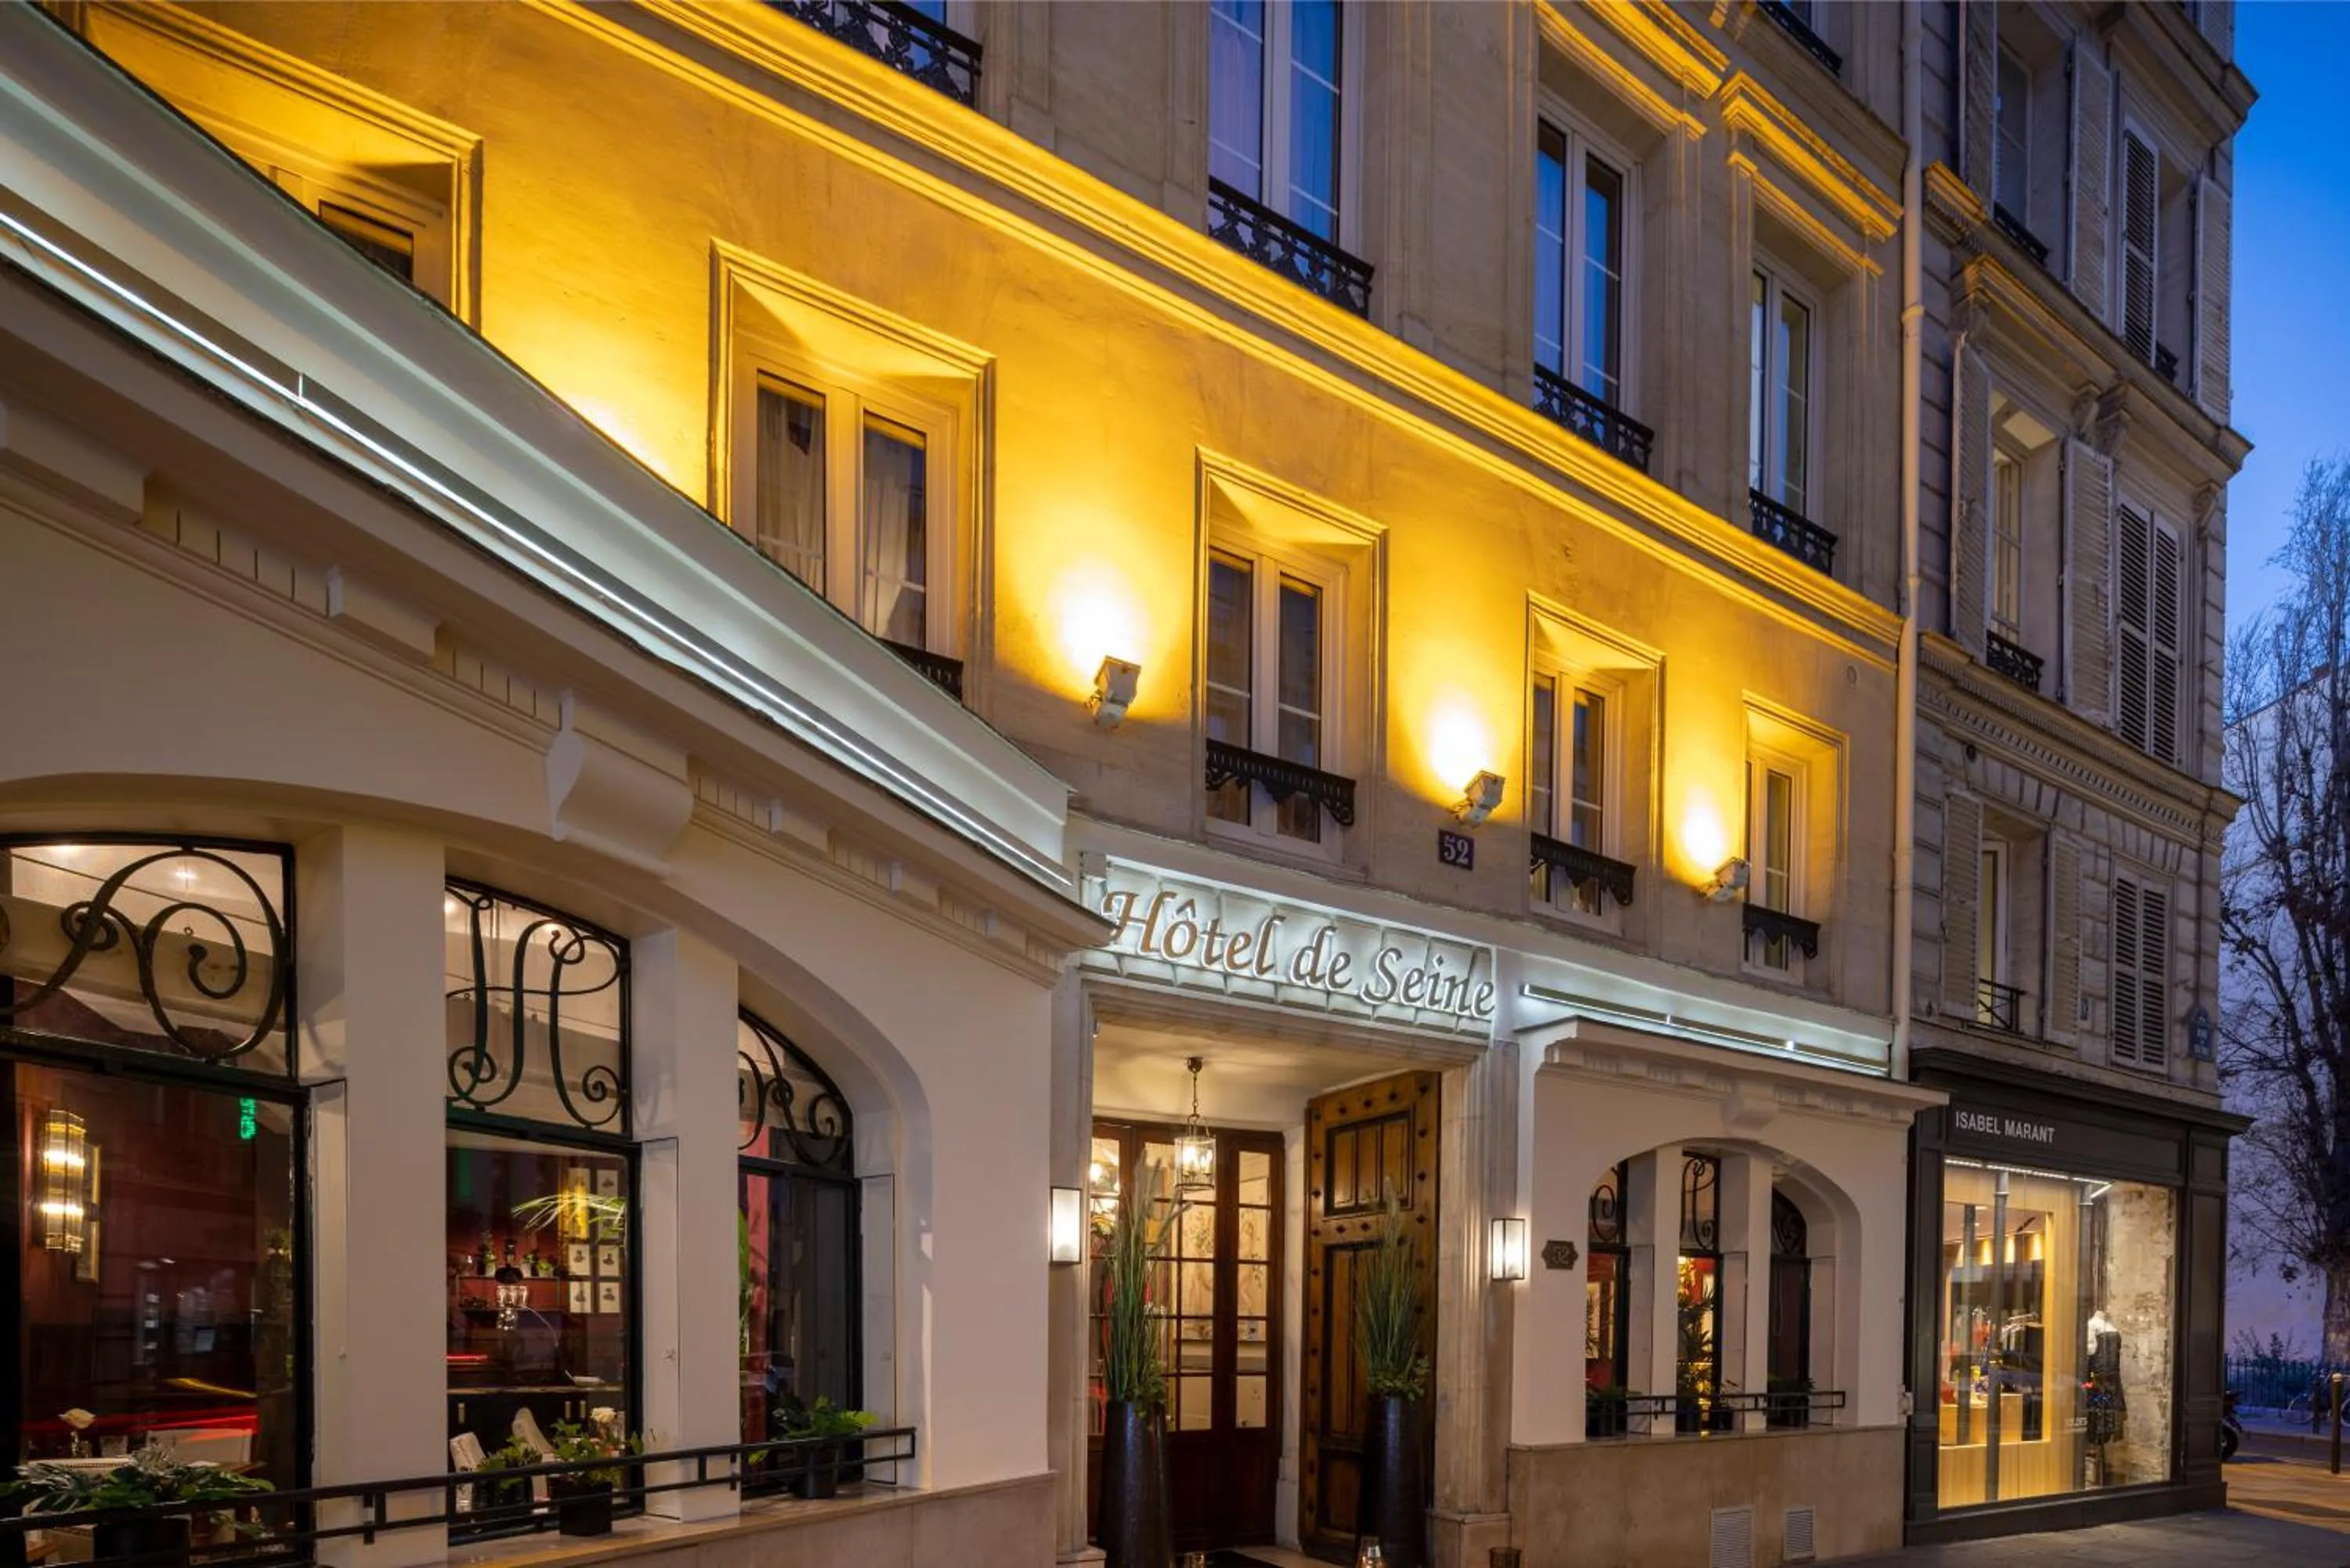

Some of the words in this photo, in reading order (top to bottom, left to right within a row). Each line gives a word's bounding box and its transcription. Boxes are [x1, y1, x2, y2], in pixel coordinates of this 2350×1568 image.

[1444, 835, 1469, 865] 52
[1101, 891, 1287, 977] Hôtel
[1291, 925, 1353, 991] de
[1359, 948, 1495, 1017] Seine
[1956, 1111, 2001, 1135] ISABEL
[2005, 1120, 2055, 1143] MARANT
